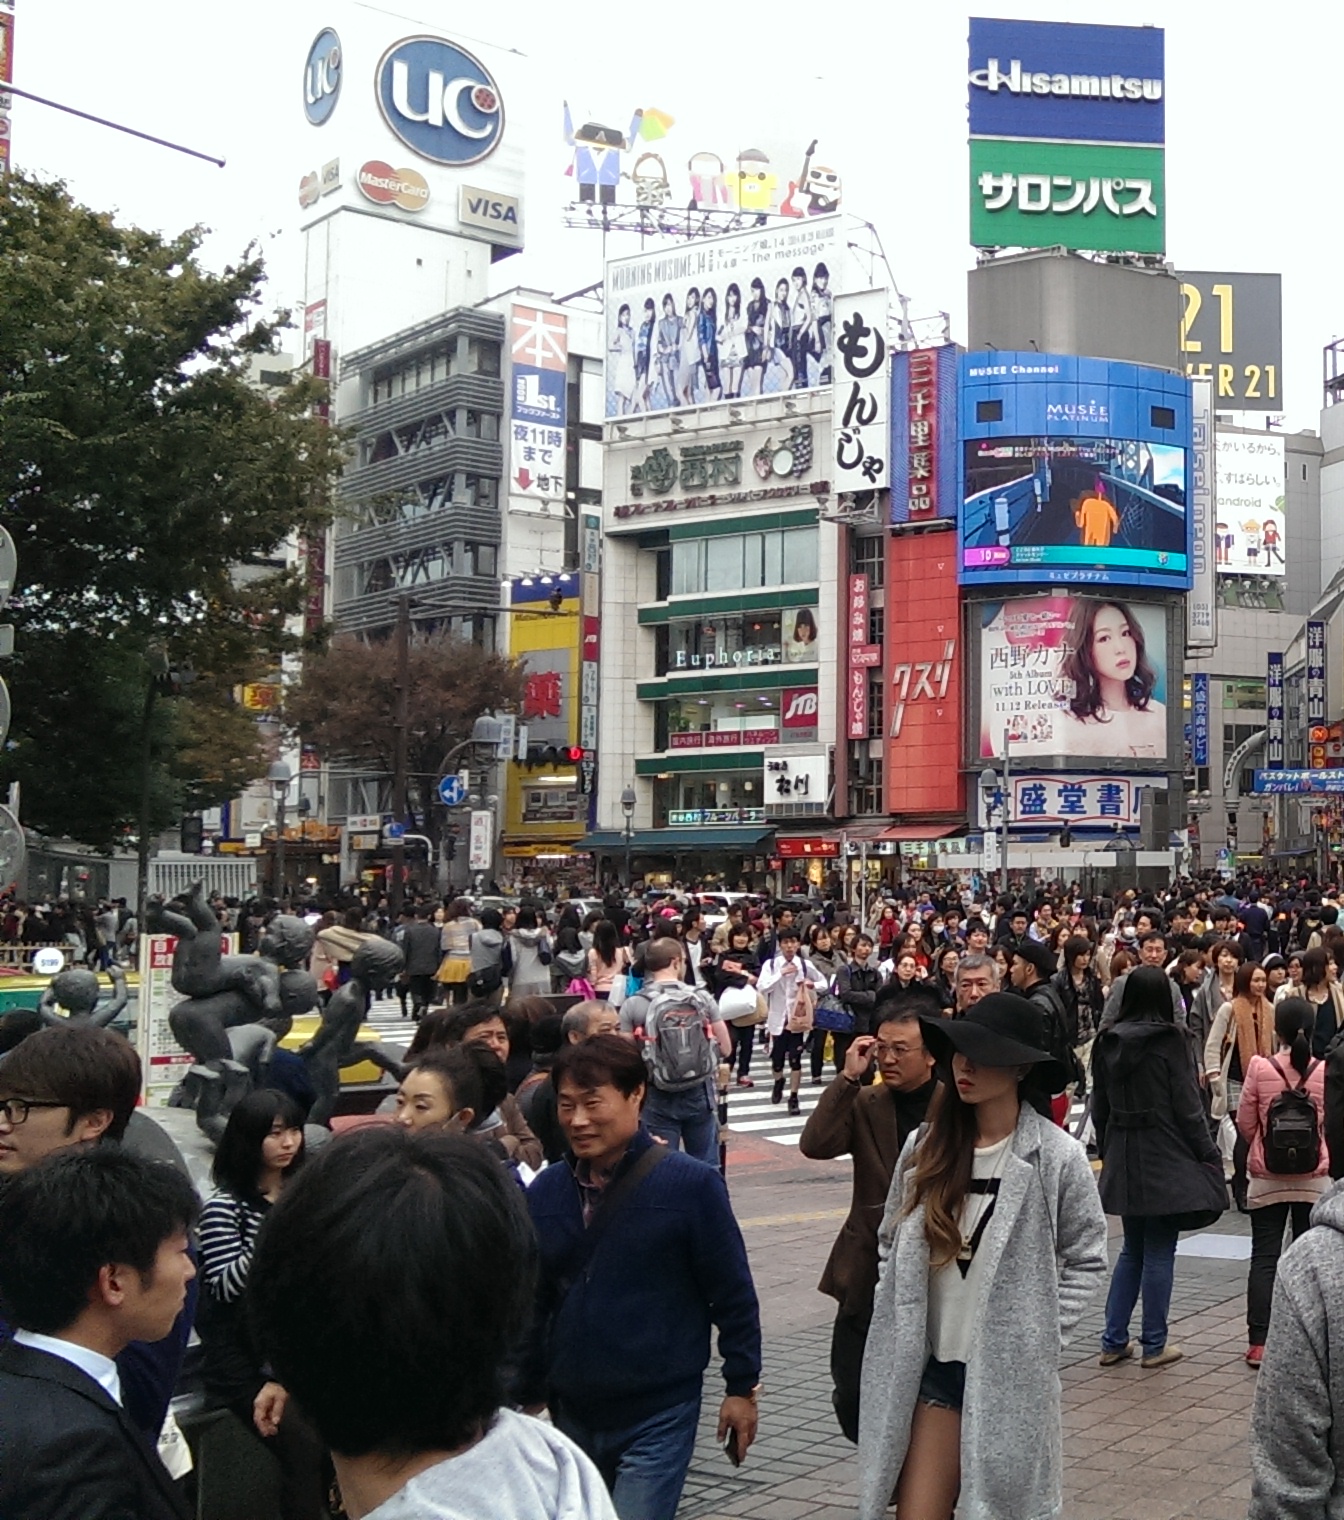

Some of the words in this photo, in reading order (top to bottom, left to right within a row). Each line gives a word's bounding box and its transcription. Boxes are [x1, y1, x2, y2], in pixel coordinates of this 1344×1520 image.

[969, 58, 1162, 100] Hisamitsu
[360, 171, 429, 198] MasterCard
[978, 171, 1157, 217] サロンパス
[467, 197, 518, 225] VISA
[1180, 283, 1233, 354] 21
[513, 310, 567, 368] 本
[969, 366, 1006, 377] MUSEE
[1011, 364, 1059, 375] Channel
[1245, 364, 1276, 398] 21
[836, 311, 885, 484] もんじゃ
[522, 445, 553, 466] まで
[536, 473, 563, 494] 地下
[1217, 496, 1262, 508] android
[675, 645, 775, 671] Euphoria
[990, 641, 1075, 670] 西野カナ
[1308, 626, 1324, 718] 洋服の青山
[784, 692, 818, 720] JTB
[1269, 663, 1283, 761] 洋服の青山
